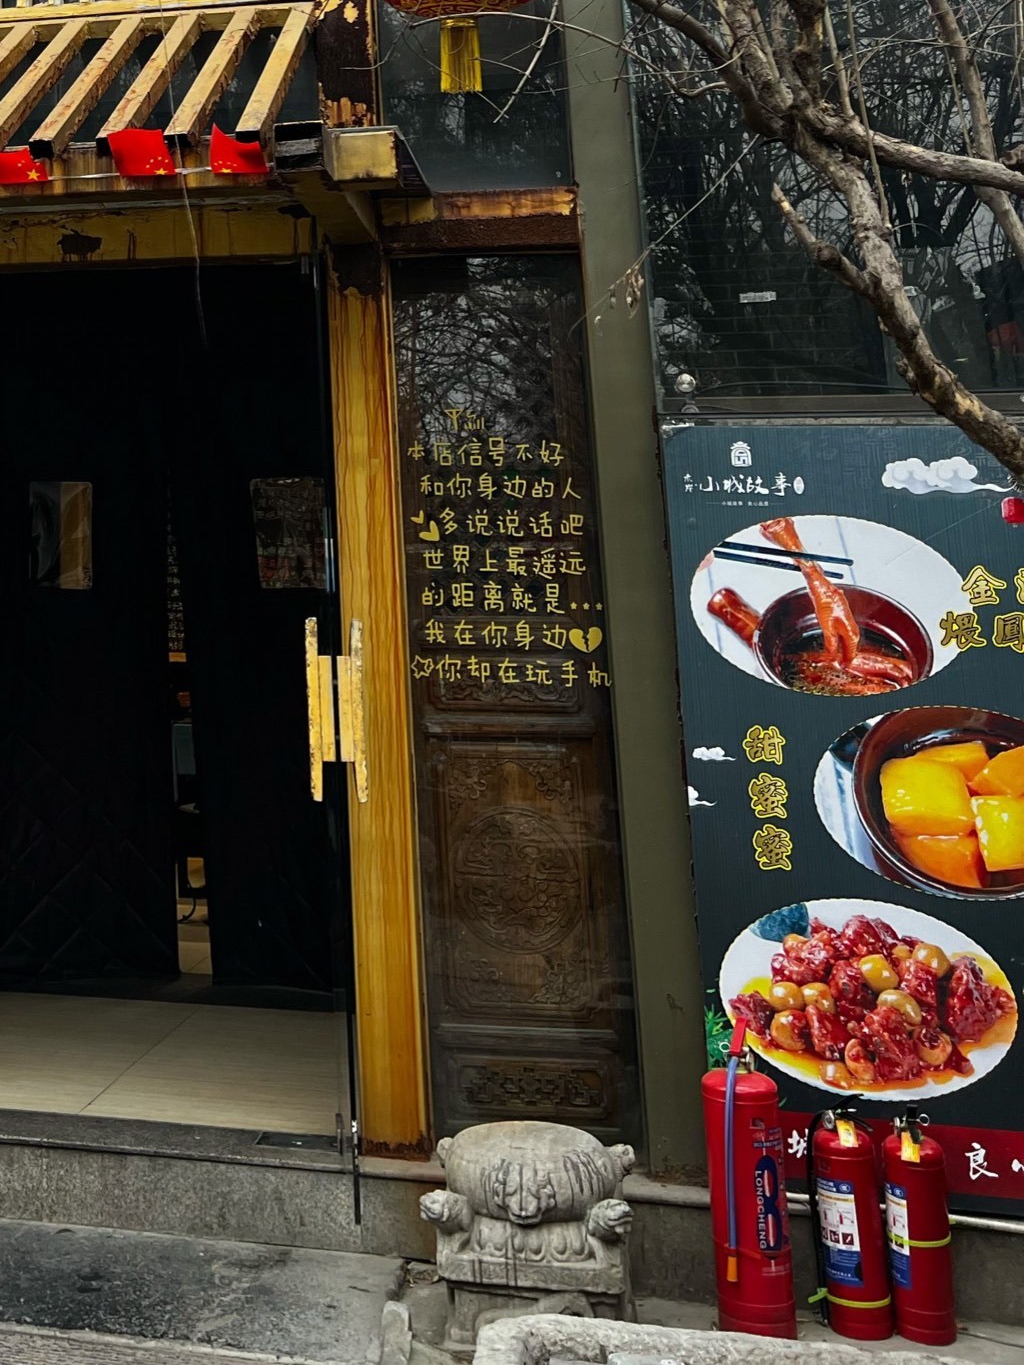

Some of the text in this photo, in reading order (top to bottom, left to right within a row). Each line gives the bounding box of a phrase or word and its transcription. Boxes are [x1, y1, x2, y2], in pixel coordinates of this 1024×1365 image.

[407, 437, 564, 467] 本店信号不好
[420, 472, 581, 500] 和你身边的人
[699, 472, 791, 496] 小城故事
[439, 507, 584, 537] 多说说话吧
[423, 545, 586, 579] 世界上最遥远
[422, 579, 565, 614] 的距离就是
[961, 565, 1024, 608] 金
[425, 618, 567, 650] 我在你身边
[436, 653, 612, 688] 你却在玩手机
[742, 725, 793, 871] 甜蜜蜜
[755, 1171, 767, 1249] LONGCHENG
